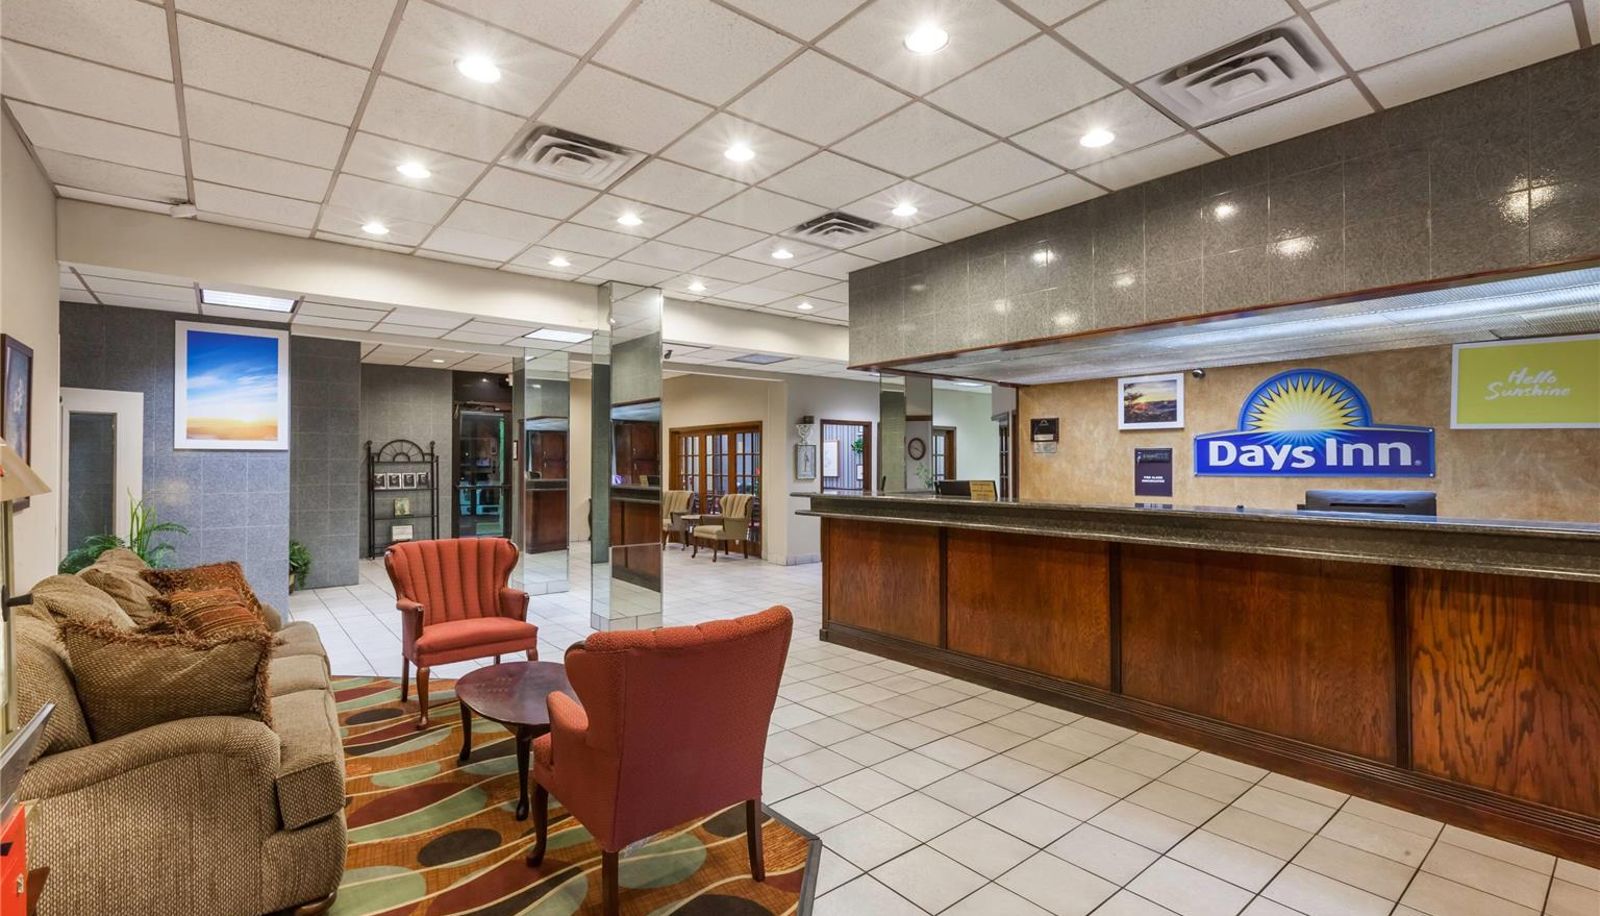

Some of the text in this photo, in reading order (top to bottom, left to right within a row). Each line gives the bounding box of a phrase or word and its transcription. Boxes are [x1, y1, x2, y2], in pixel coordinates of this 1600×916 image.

[1508, 367, 1557, 384] Hello
[1484, 382, 1571, 401] Sunshine
[1208, 438, 1412, 471] Days Inn
